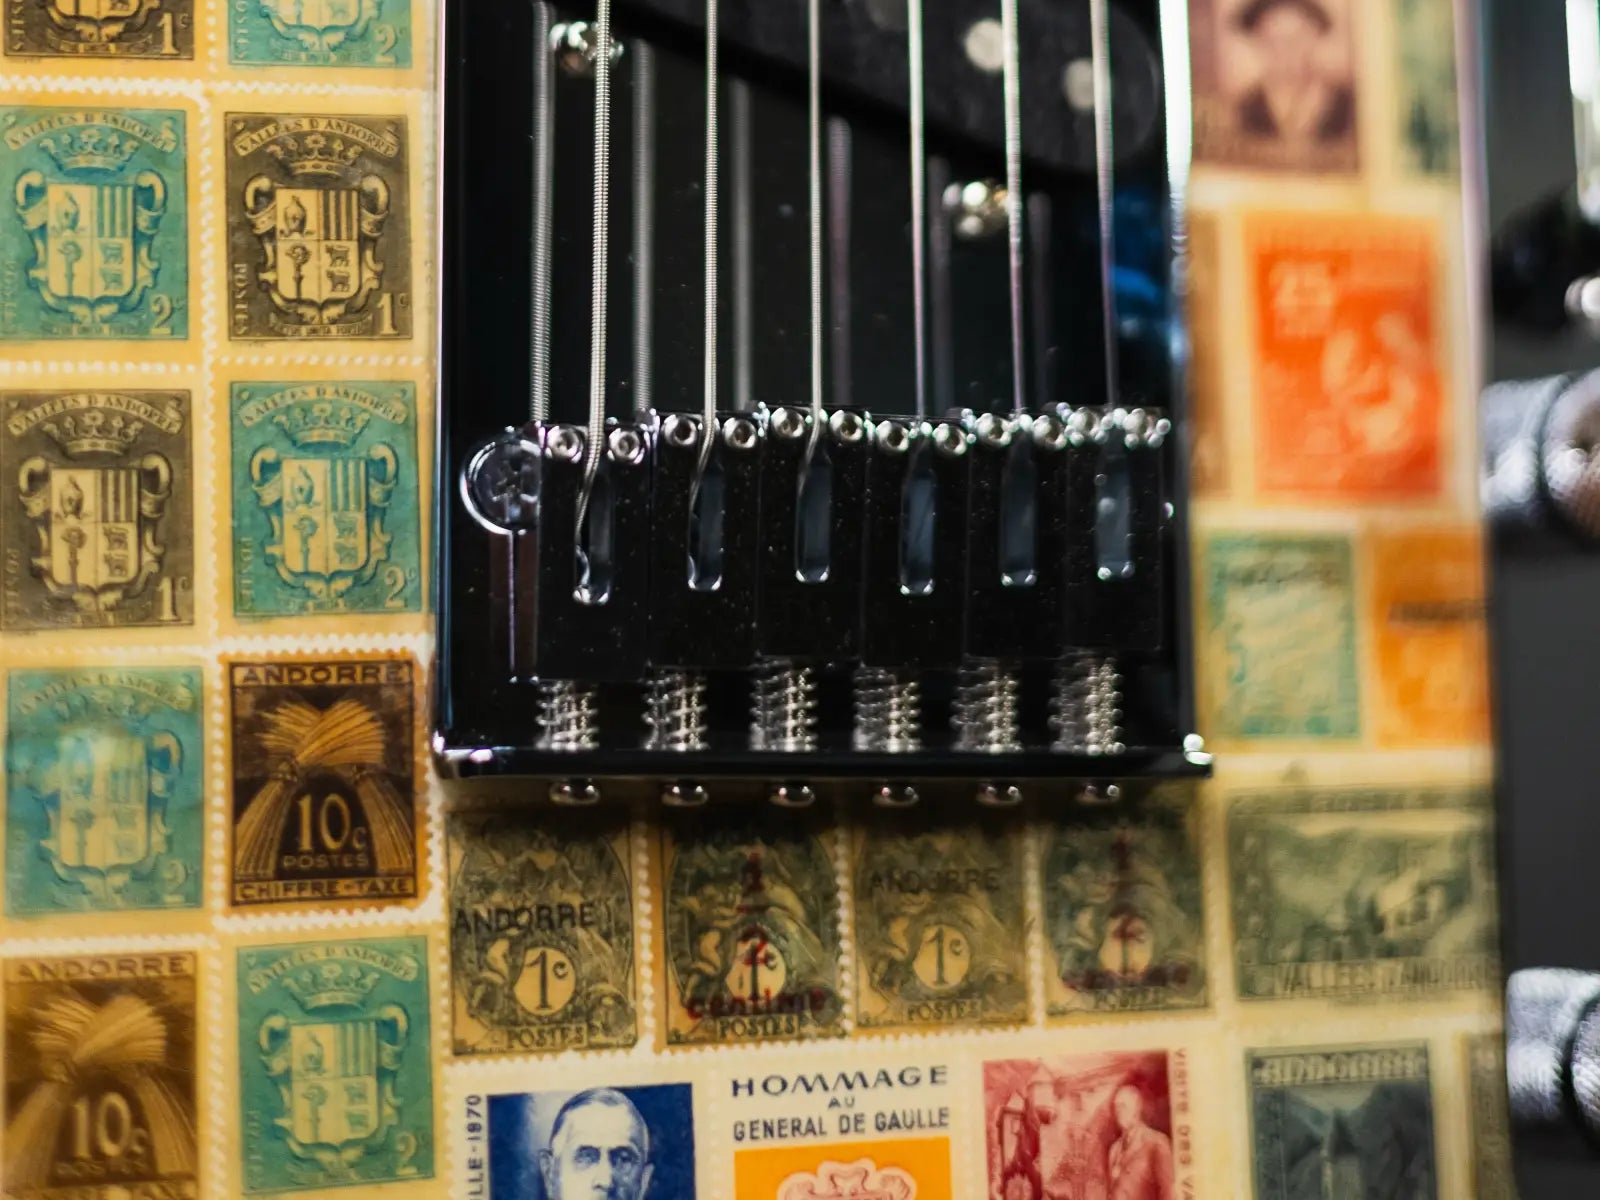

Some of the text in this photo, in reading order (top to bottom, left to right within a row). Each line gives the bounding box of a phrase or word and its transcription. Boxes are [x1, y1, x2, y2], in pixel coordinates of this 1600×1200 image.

[234, 263, 249, 335] POSTES
[242, 663, 406, 684] ANDORRE
[283, 853, 370, 869] POSTES
[455, 902, 595, 935] ANDORRE
[18, 956, 188, 980] ANDORRE
[508, 1025, 584, 1049] POSTES
[718, 1015, 796, 1038] POSTES
[731, 1064, 949, 1098] HOMMAGE
[828, 1097, 856, 1110] AU
[733, 1106, 951, 1143] GENERAL DE GAULLE
